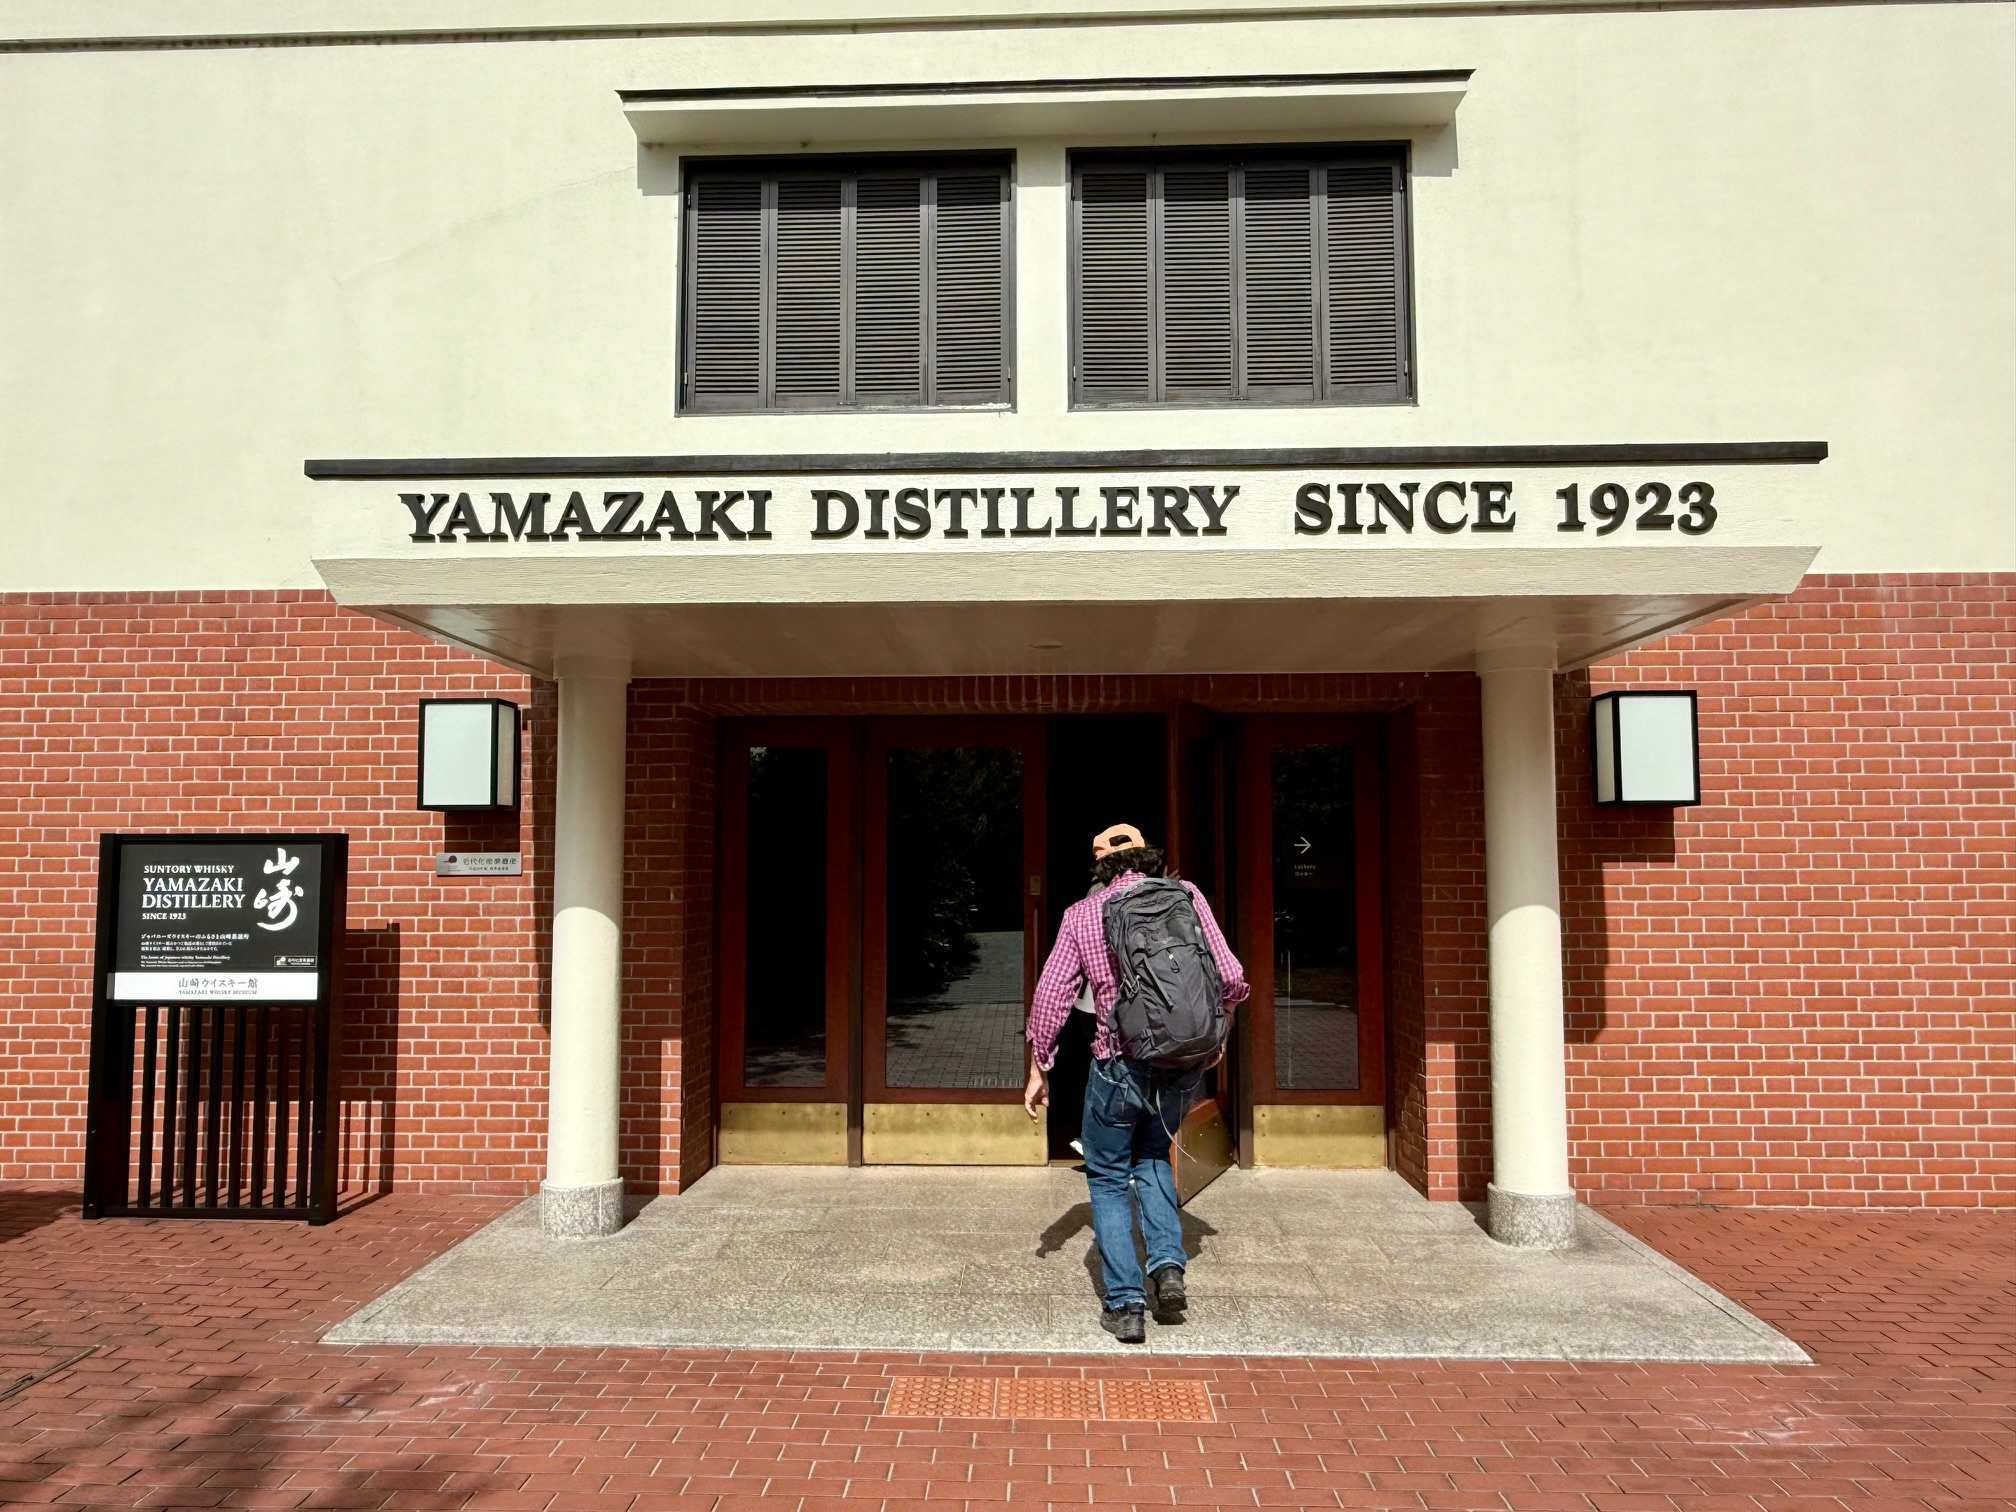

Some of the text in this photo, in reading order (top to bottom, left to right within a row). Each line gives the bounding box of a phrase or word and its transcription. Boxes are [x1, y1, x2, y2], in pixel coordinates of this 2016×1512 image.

[397, 481, 1718, 544] YAMAZAKI DISTILLERY SINCE 1923
[143, 865, 234, 874] SUNTORY WHISKY
[143, 877, 244, 892] YAMAZAKI
[141, 894, 246, 909] DISTILLERY
[142, 912, 187, 920] SINCE 1923
